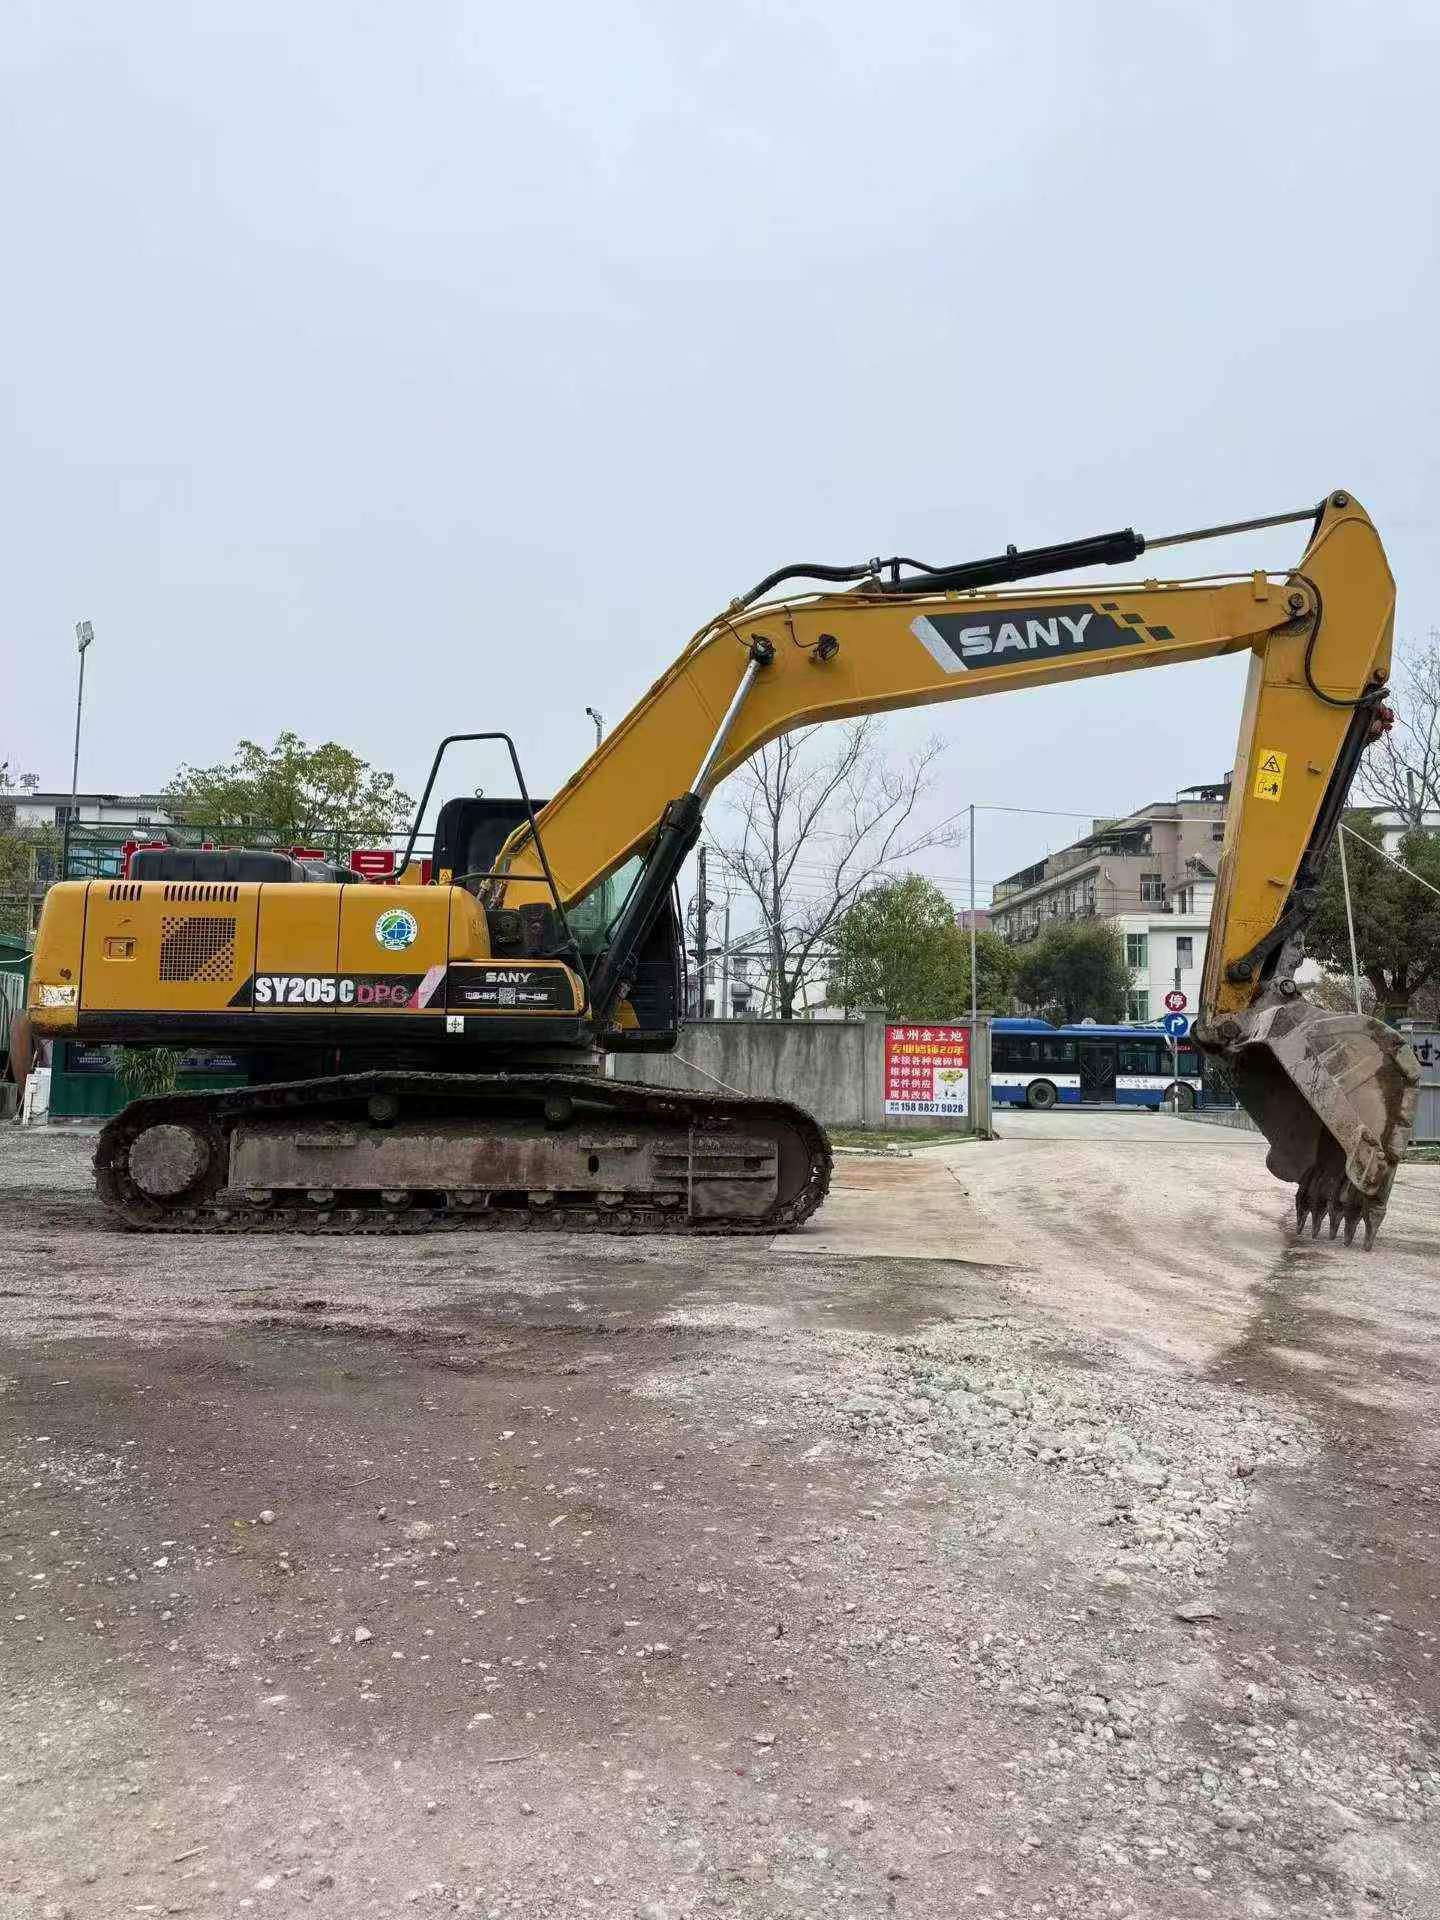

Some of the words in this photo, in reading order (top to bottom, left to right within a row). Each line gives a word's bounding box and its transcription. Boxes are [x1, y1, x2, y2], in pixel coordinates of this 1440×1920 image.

[959, 613, 1093, 657] SANY
[486, 972, 530, 983] SANY
[254, 977, 355, 1003] SY205C
[891, 1028, 964, 1042] 温州金土地
[890, 1079, 932, 1089] 配件供应
